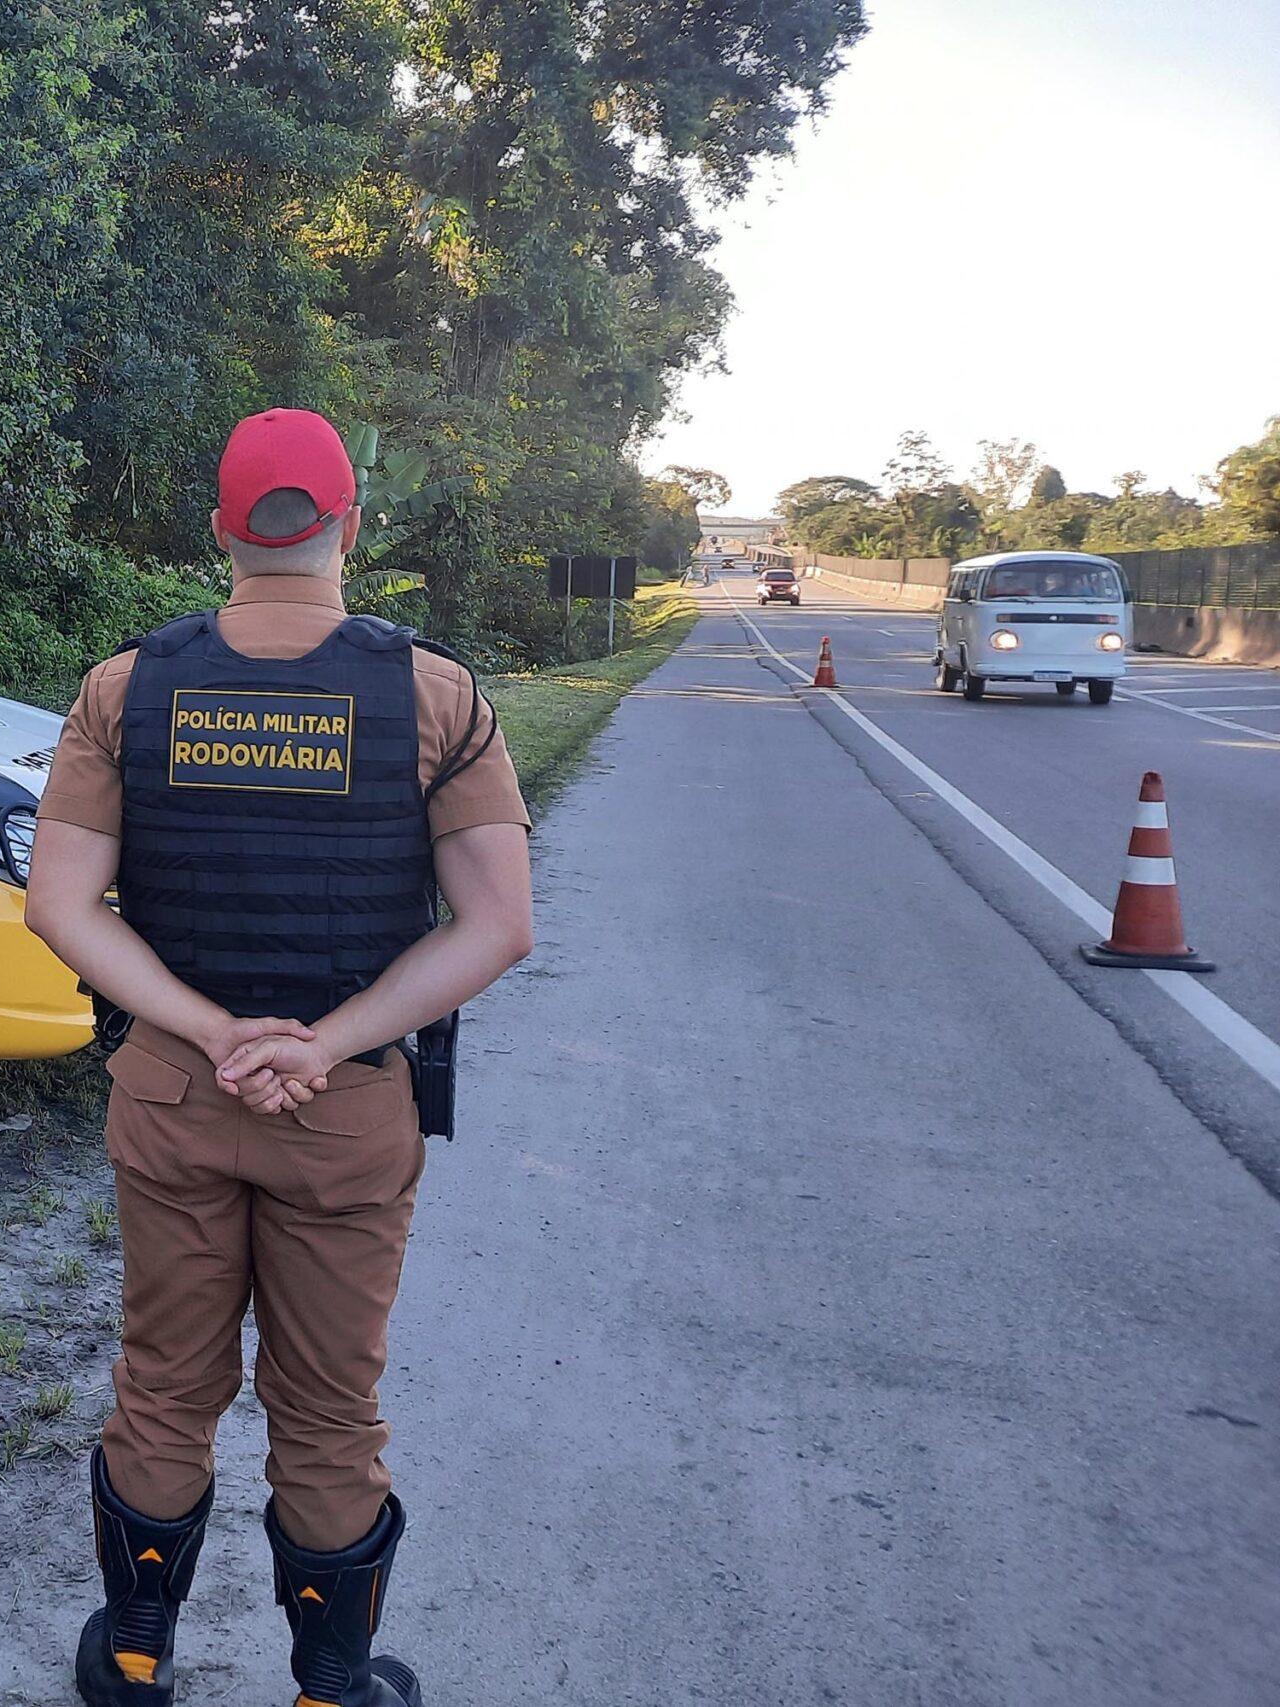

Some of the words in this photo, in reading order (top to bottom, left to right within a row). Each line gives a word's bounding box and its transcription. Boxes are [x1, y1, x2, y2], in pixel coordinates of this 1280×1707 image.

[176, 707, 258, 732] POLÍCIA
[263, 713, 347, 736] MILITAR
[175, 740, 344, 772] RODOVIÁRIA
